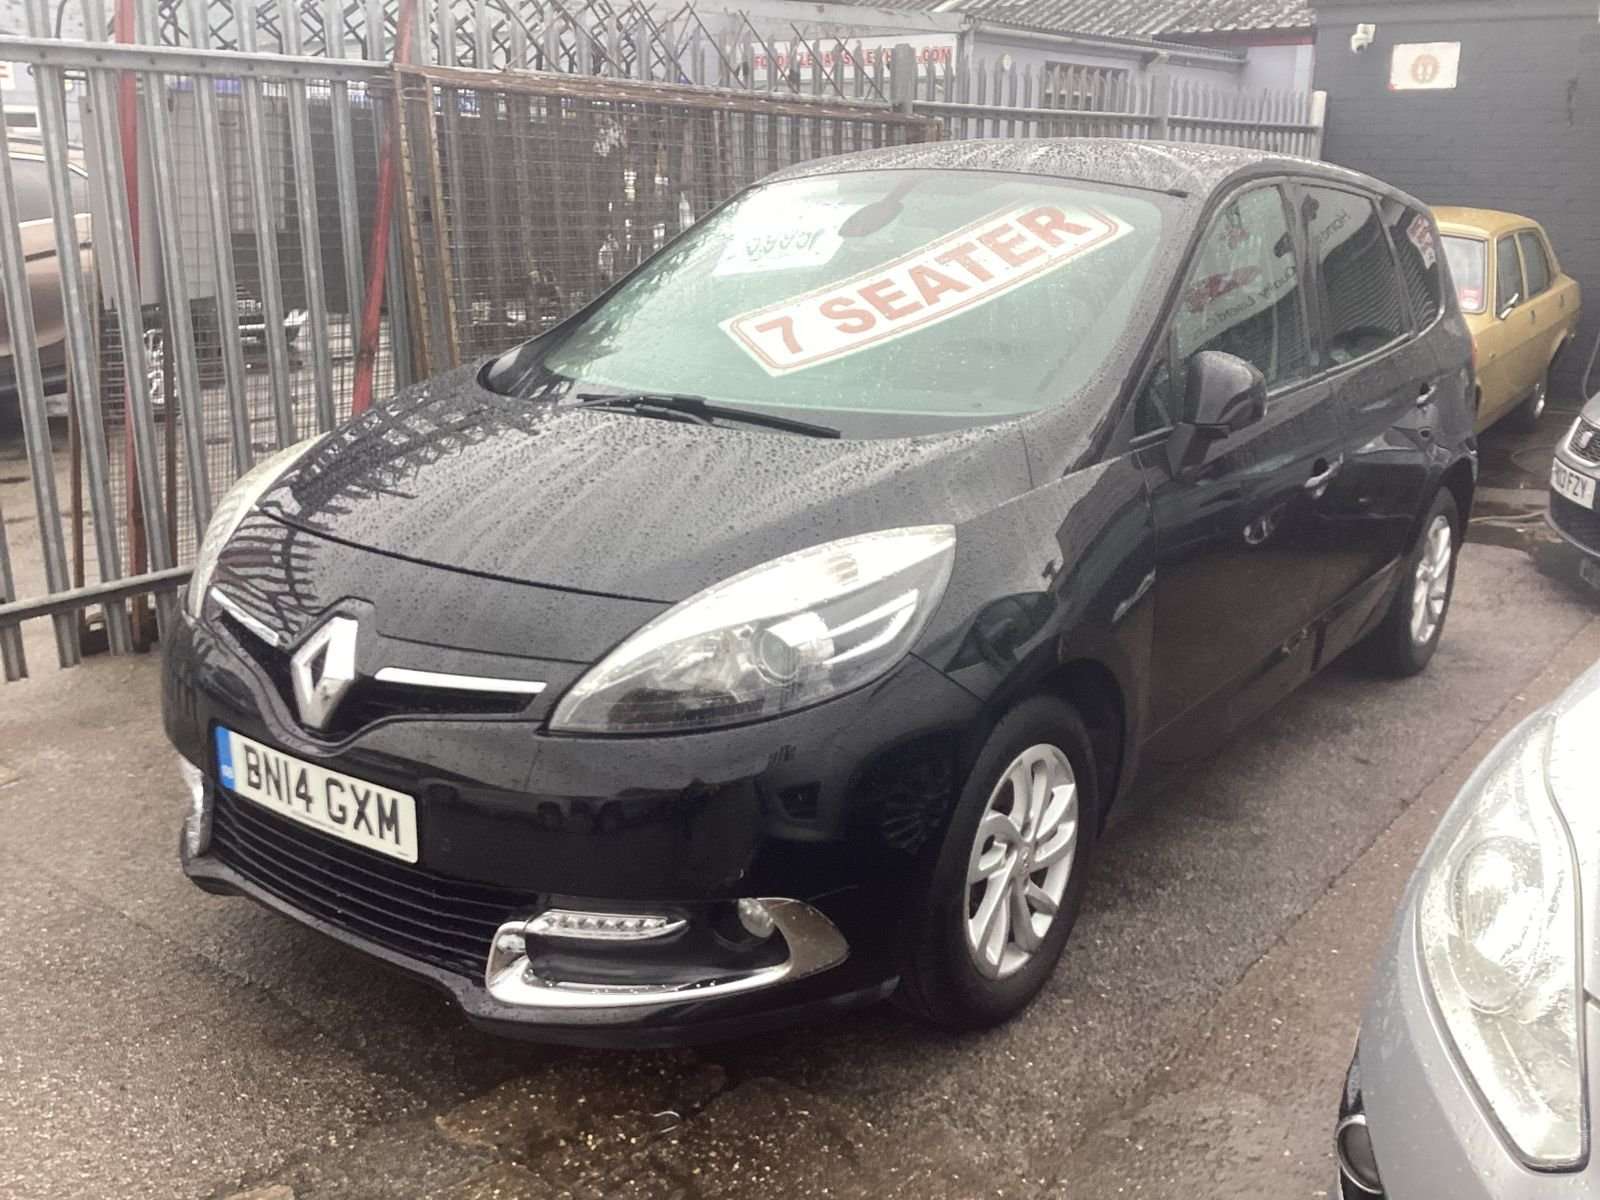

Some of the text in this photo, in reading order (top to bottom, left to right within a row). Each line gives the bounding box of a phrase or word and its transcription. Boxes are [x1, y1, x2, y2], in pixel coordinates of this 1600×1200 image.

[756, 315, 804, 355] 7
[818, 205, 1091, 335] SEATER
[243, 743, 401, 846] BN14 GXM
